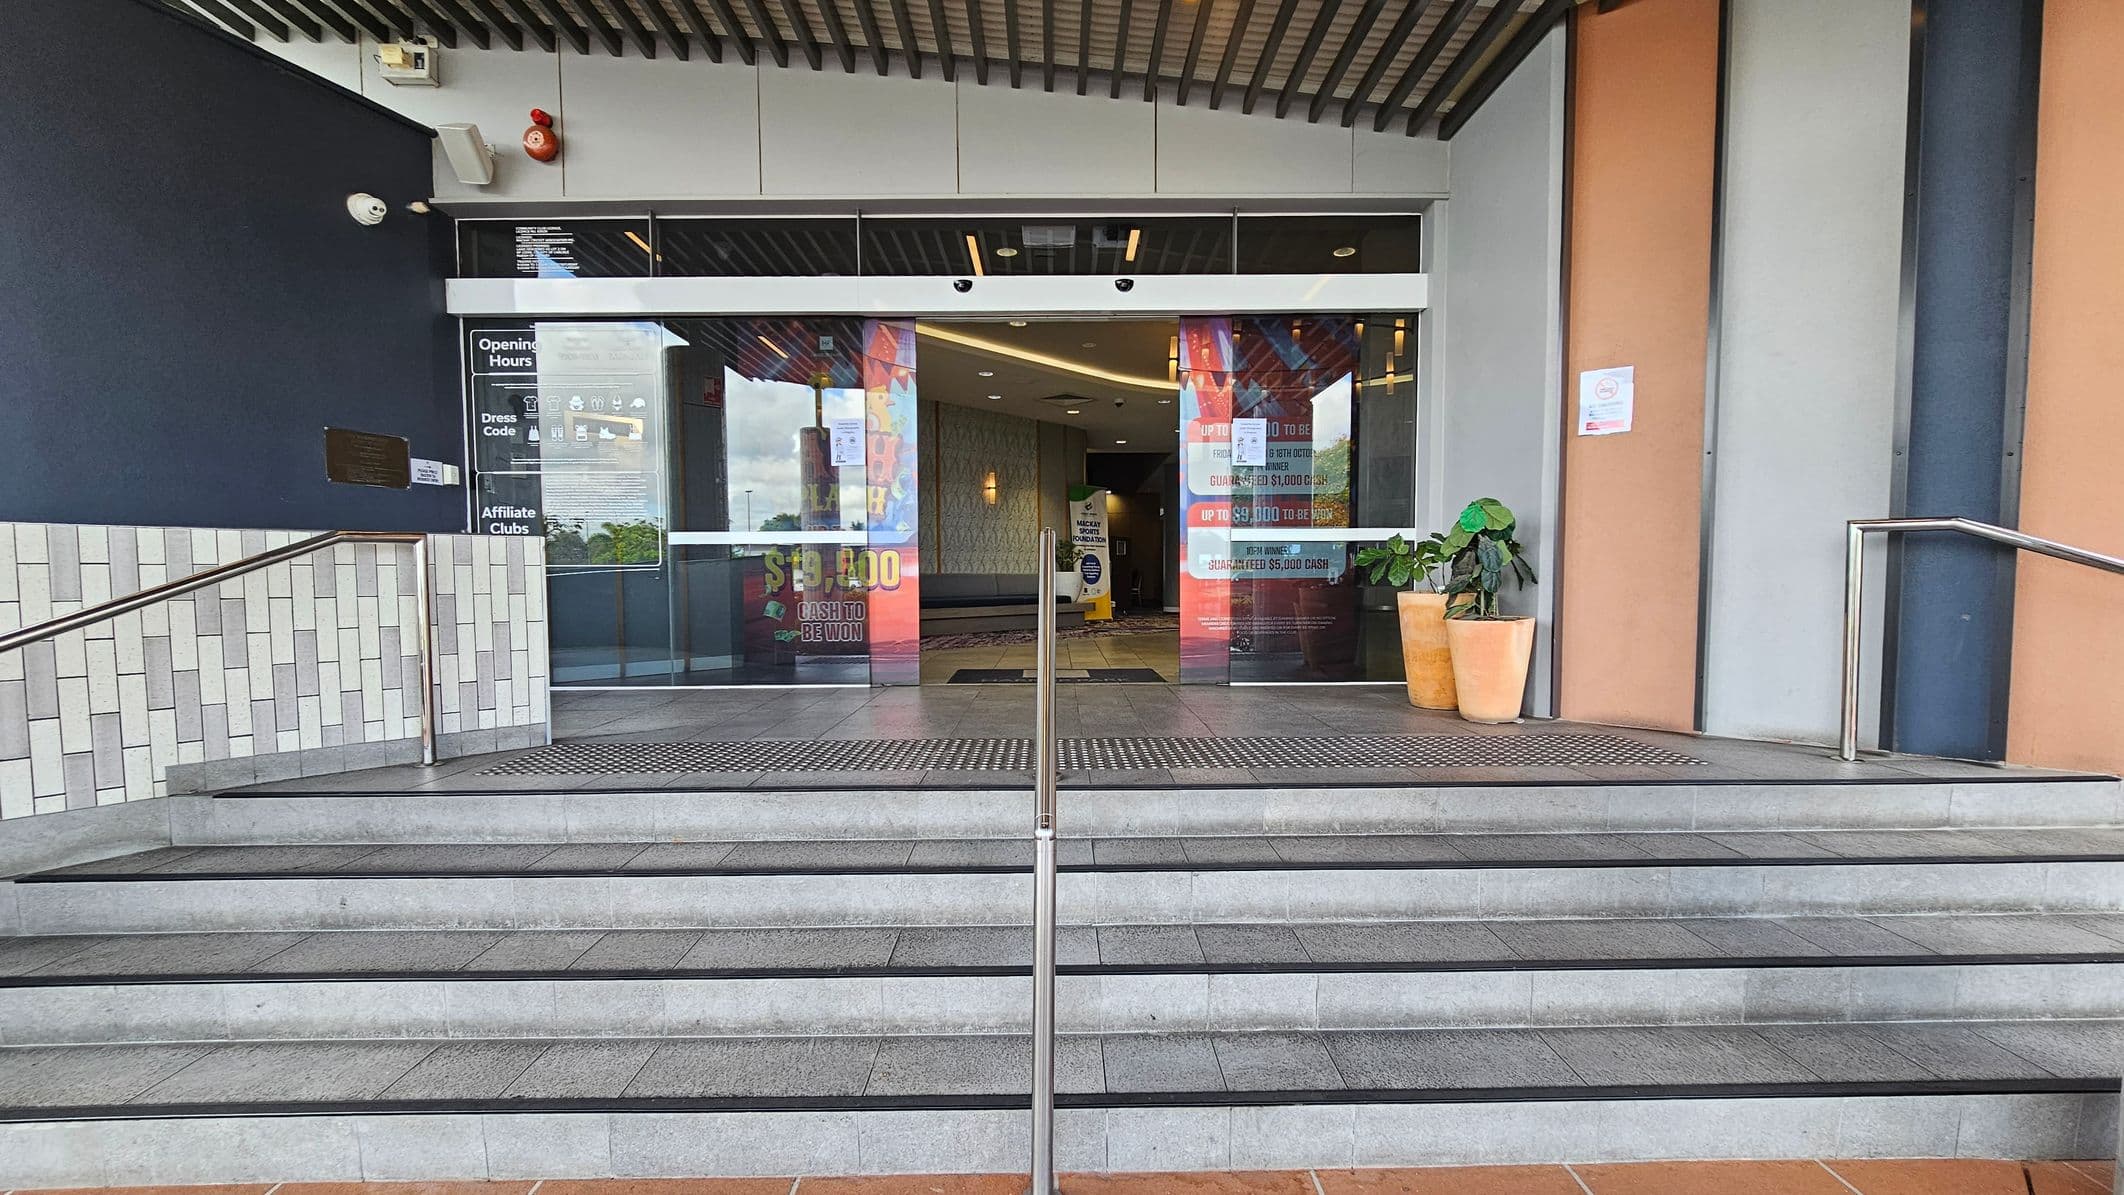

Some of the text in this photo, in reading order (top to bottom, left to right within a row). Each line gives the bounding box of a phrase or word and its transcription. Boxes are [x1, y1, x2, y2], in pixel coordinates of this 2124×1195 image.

[479, 337, 537, 353] Opening
[489, 354, 532, 367] Hours
[481, 413, 517, 423] Dress
[483, 426, 516, 436] Code
[1201, 424, 1213, 436] UP
[1217, 424, 1229, 436] TO
[1284, 424, 1296, 436] TO
[1299, 424, 1310, 436] BE
[1213, 449, 1232, 459] FRIDA
[1271, 474, 1302, 487] $1,000
[482, 506, 536, 519] Affiliate
[1201, 509, 1214, 521] UP
[1216, 509, 1229, 521] TO
[1232, 506, 1280, 523] $9,000
[1282, 509, 1295, 520] TO
[1297, 508, 1309, 520] BE
[490, 522, 529, 535] Clubs
[1077, 520, 1101, 528] MACKAY
[1264, 545, 1289, 556] WINNE
[1208, 558, 1329, 571] GUARANTEED $5,000 CASH
[798, 601, 866, 621] CASH TO
[801, 622, 863, 641] BE WON
